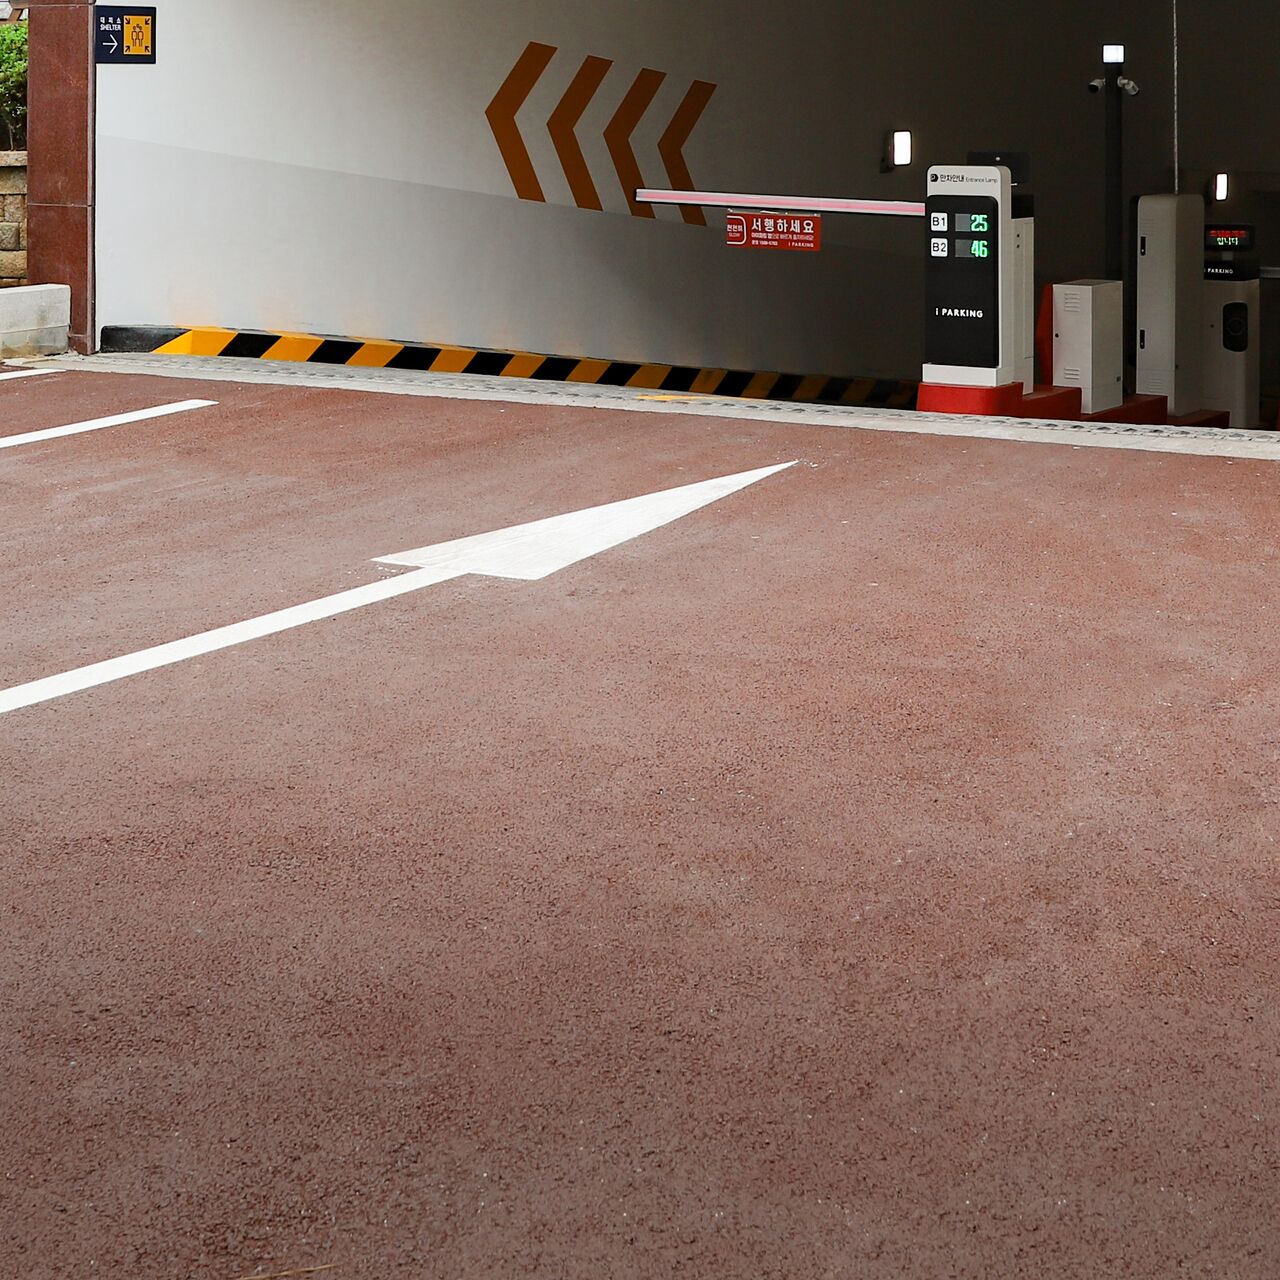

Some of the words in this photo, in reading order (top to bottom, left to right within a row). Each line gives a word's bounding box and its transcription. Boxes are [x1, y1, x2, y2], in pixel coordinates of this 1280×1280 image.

[100, 23, 122, 31] SHELTER
[751, 217, 815, 234] 서행하세요
[932, 216, 946, 227] B1
[970, 214, 988, 232] 25
[932, 242, 947, 253] B2
[970, 240, 988, 258] 46
[941, 307, 984, 319] PARKING
